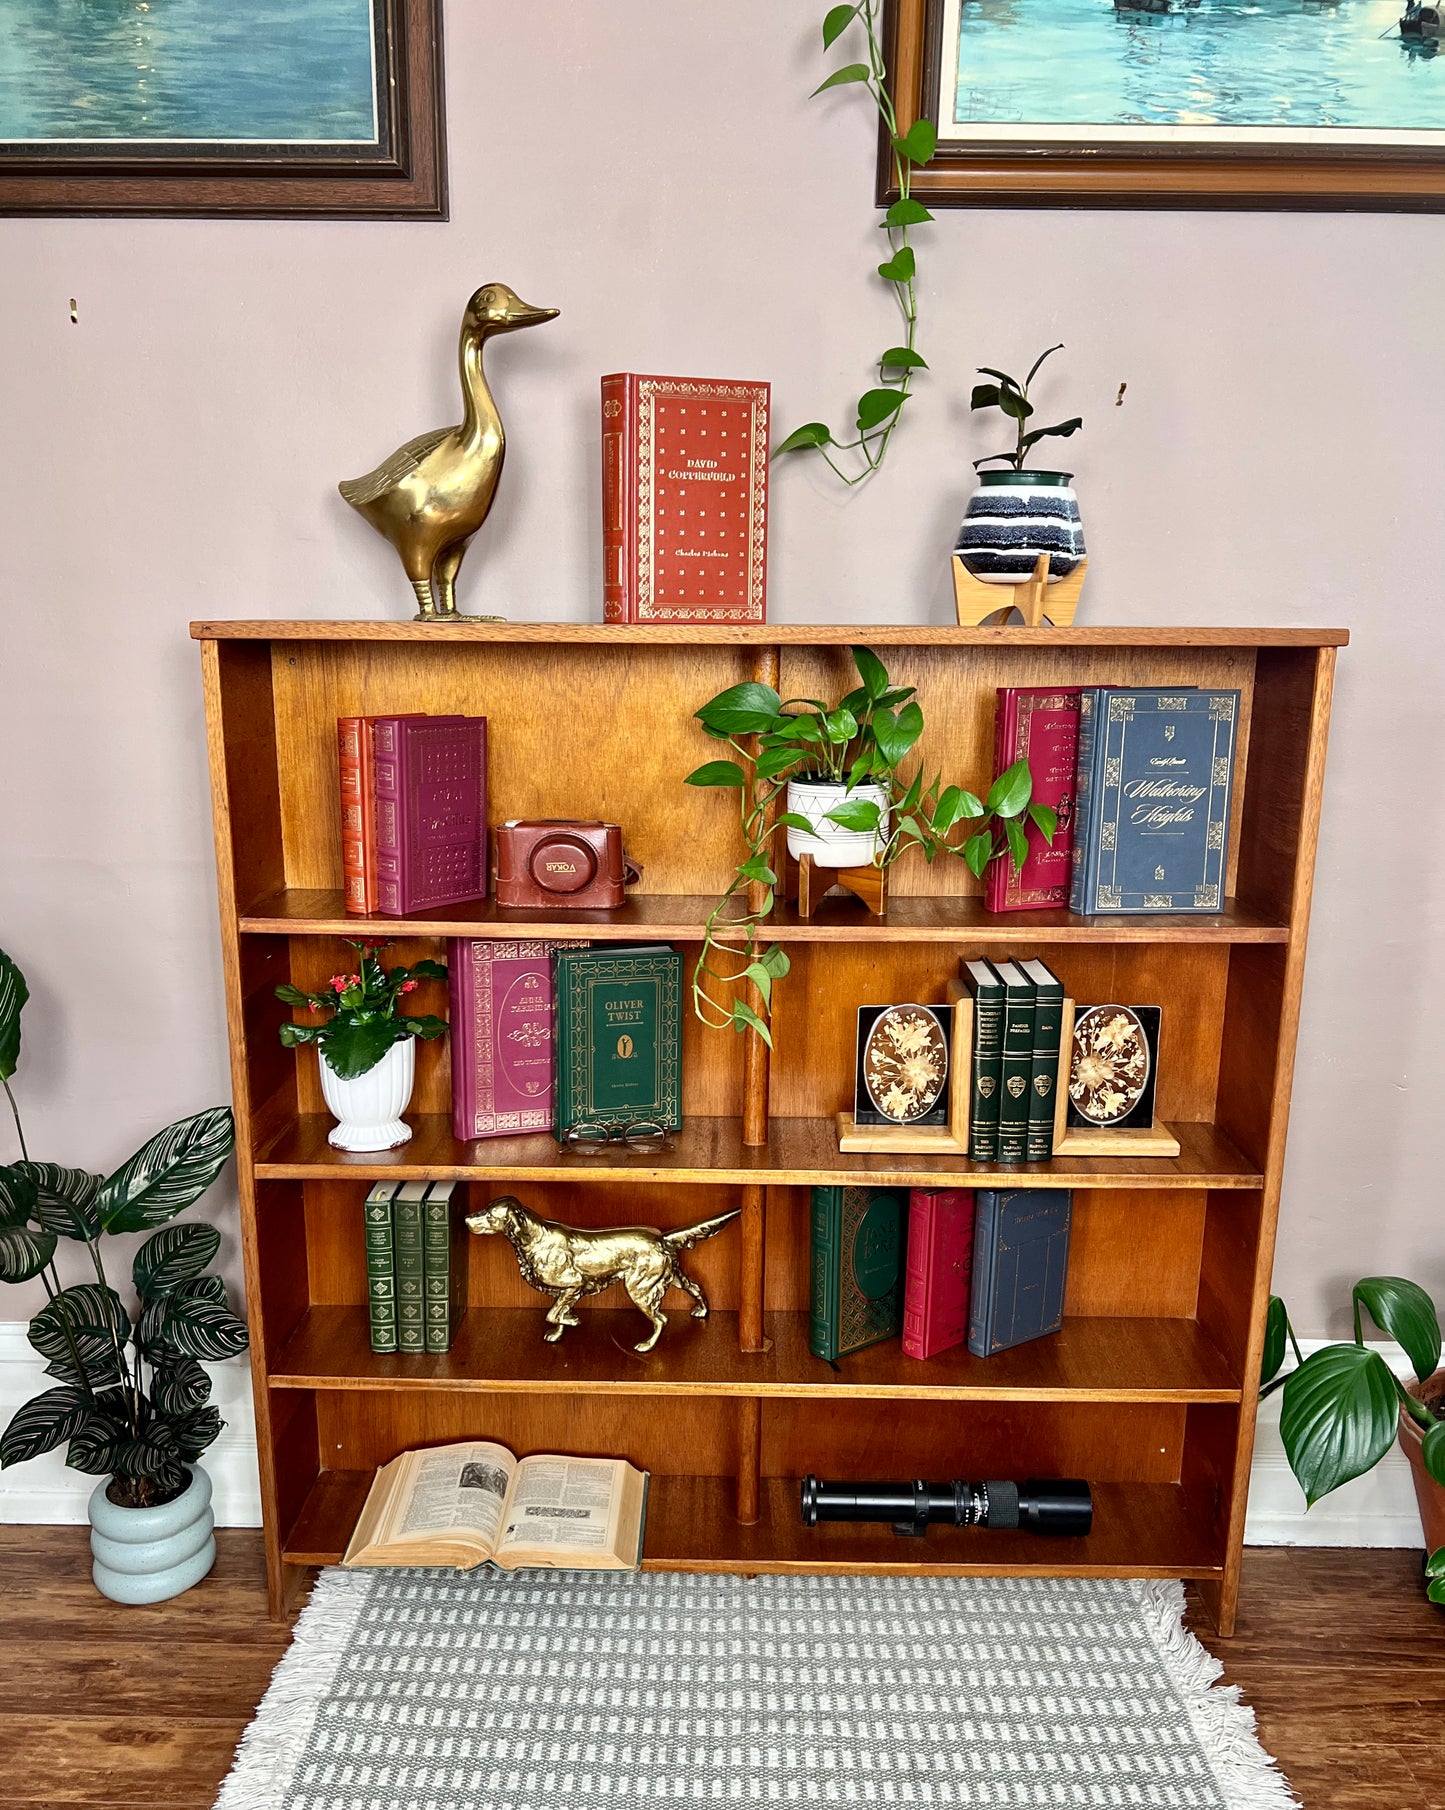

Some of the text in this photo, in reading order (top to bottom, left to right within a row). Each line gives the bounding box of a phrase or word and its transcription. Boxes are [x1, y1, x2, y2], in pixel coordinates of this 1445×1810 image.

[687, 459, 718, 469] DAVID
[668, 470, 736, 482] COPPERFIELD
[1123, 779, 1207, 804] Wuthering
[1130, 803, 1195, 830] Heights
[546, 862, 576, 873] VOKAR
[604, 1000, 644, 1011] OLIVER
[607, 1011, 641, 1022] TWIST
[864, 1219, 897, 1246] JANE
